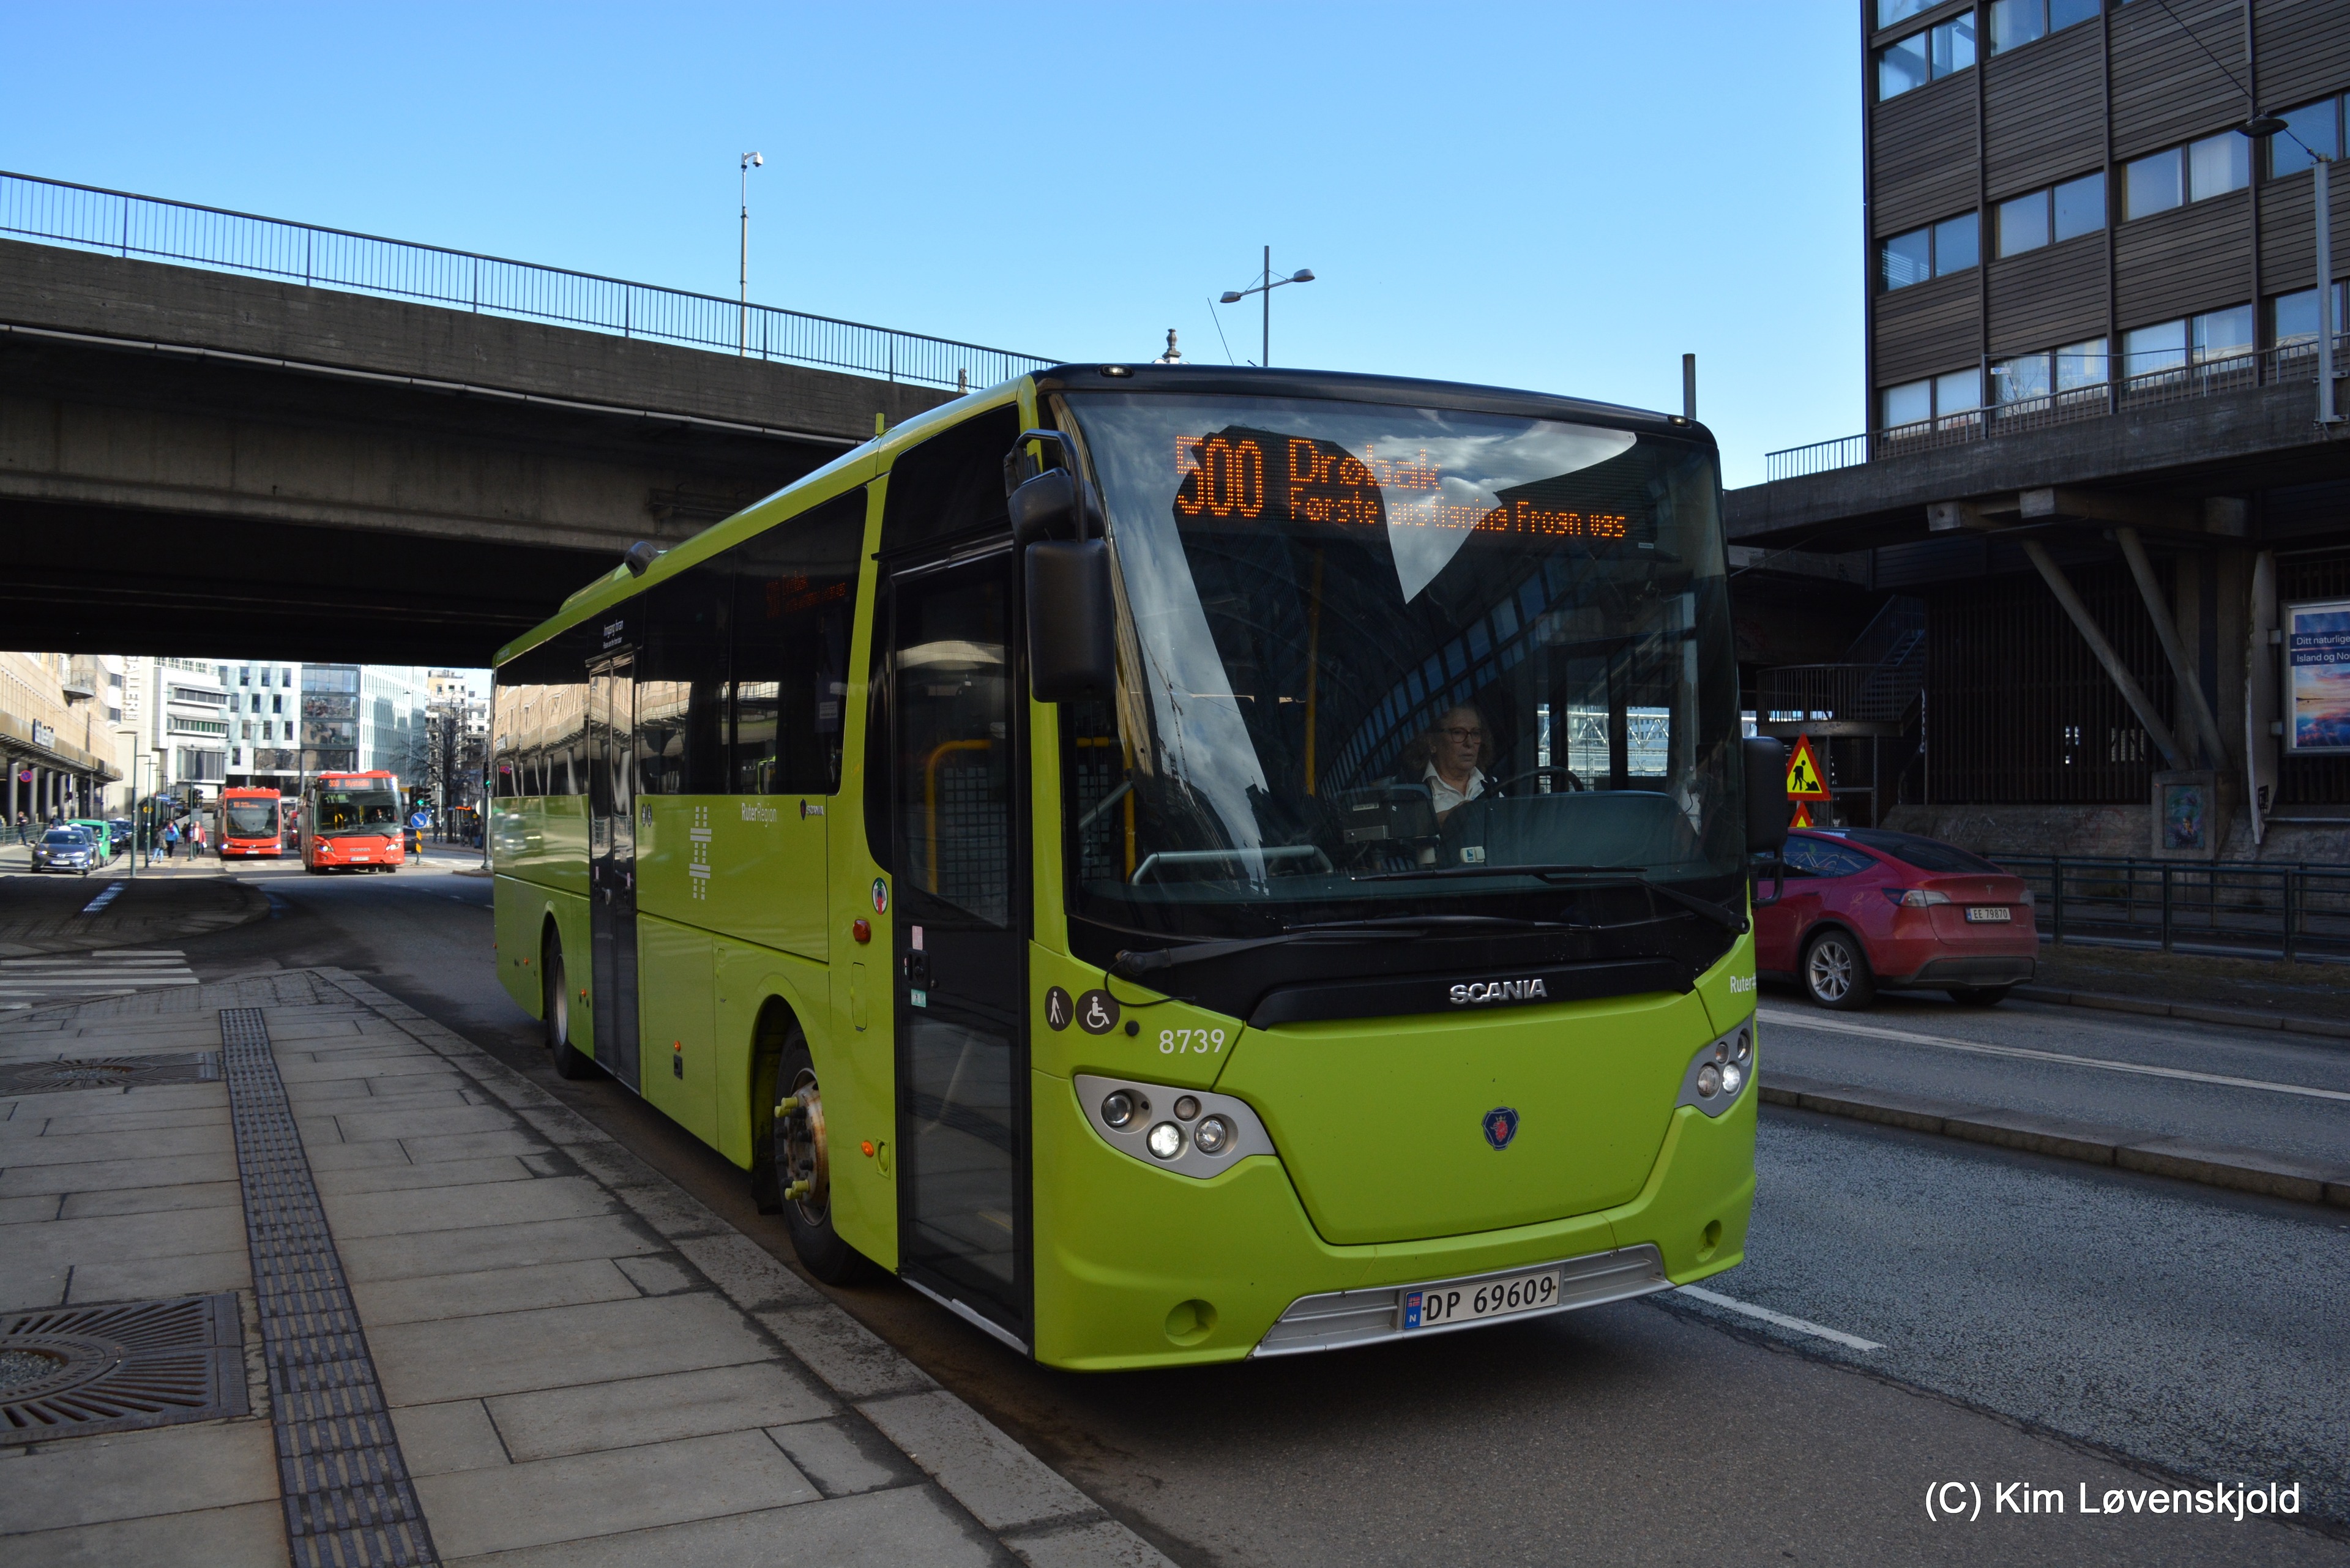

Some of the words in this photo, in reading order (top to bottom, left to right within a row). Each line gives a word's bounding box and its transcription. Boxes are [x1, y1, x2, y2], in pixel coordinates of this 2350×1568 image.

[1176, 435, 1263, 517] 500
[1289, 438, 1442, 490] Drøbak
[1290, 487, 1378, 524] Første
[2297, 653, 2322, 662] Island
[2323, 654, 2335, 663] og
[1973, 909, 1983, 919] EE
[1985, 909, 2008, 919] 79870
[1450, 978, 1548, 1005] SCANIA
[1158, 1028, 1225, 1055] 8739
[1426, 1291, 1461, 1321] DP
[1473, 1276, 1553, 1314] 69609
